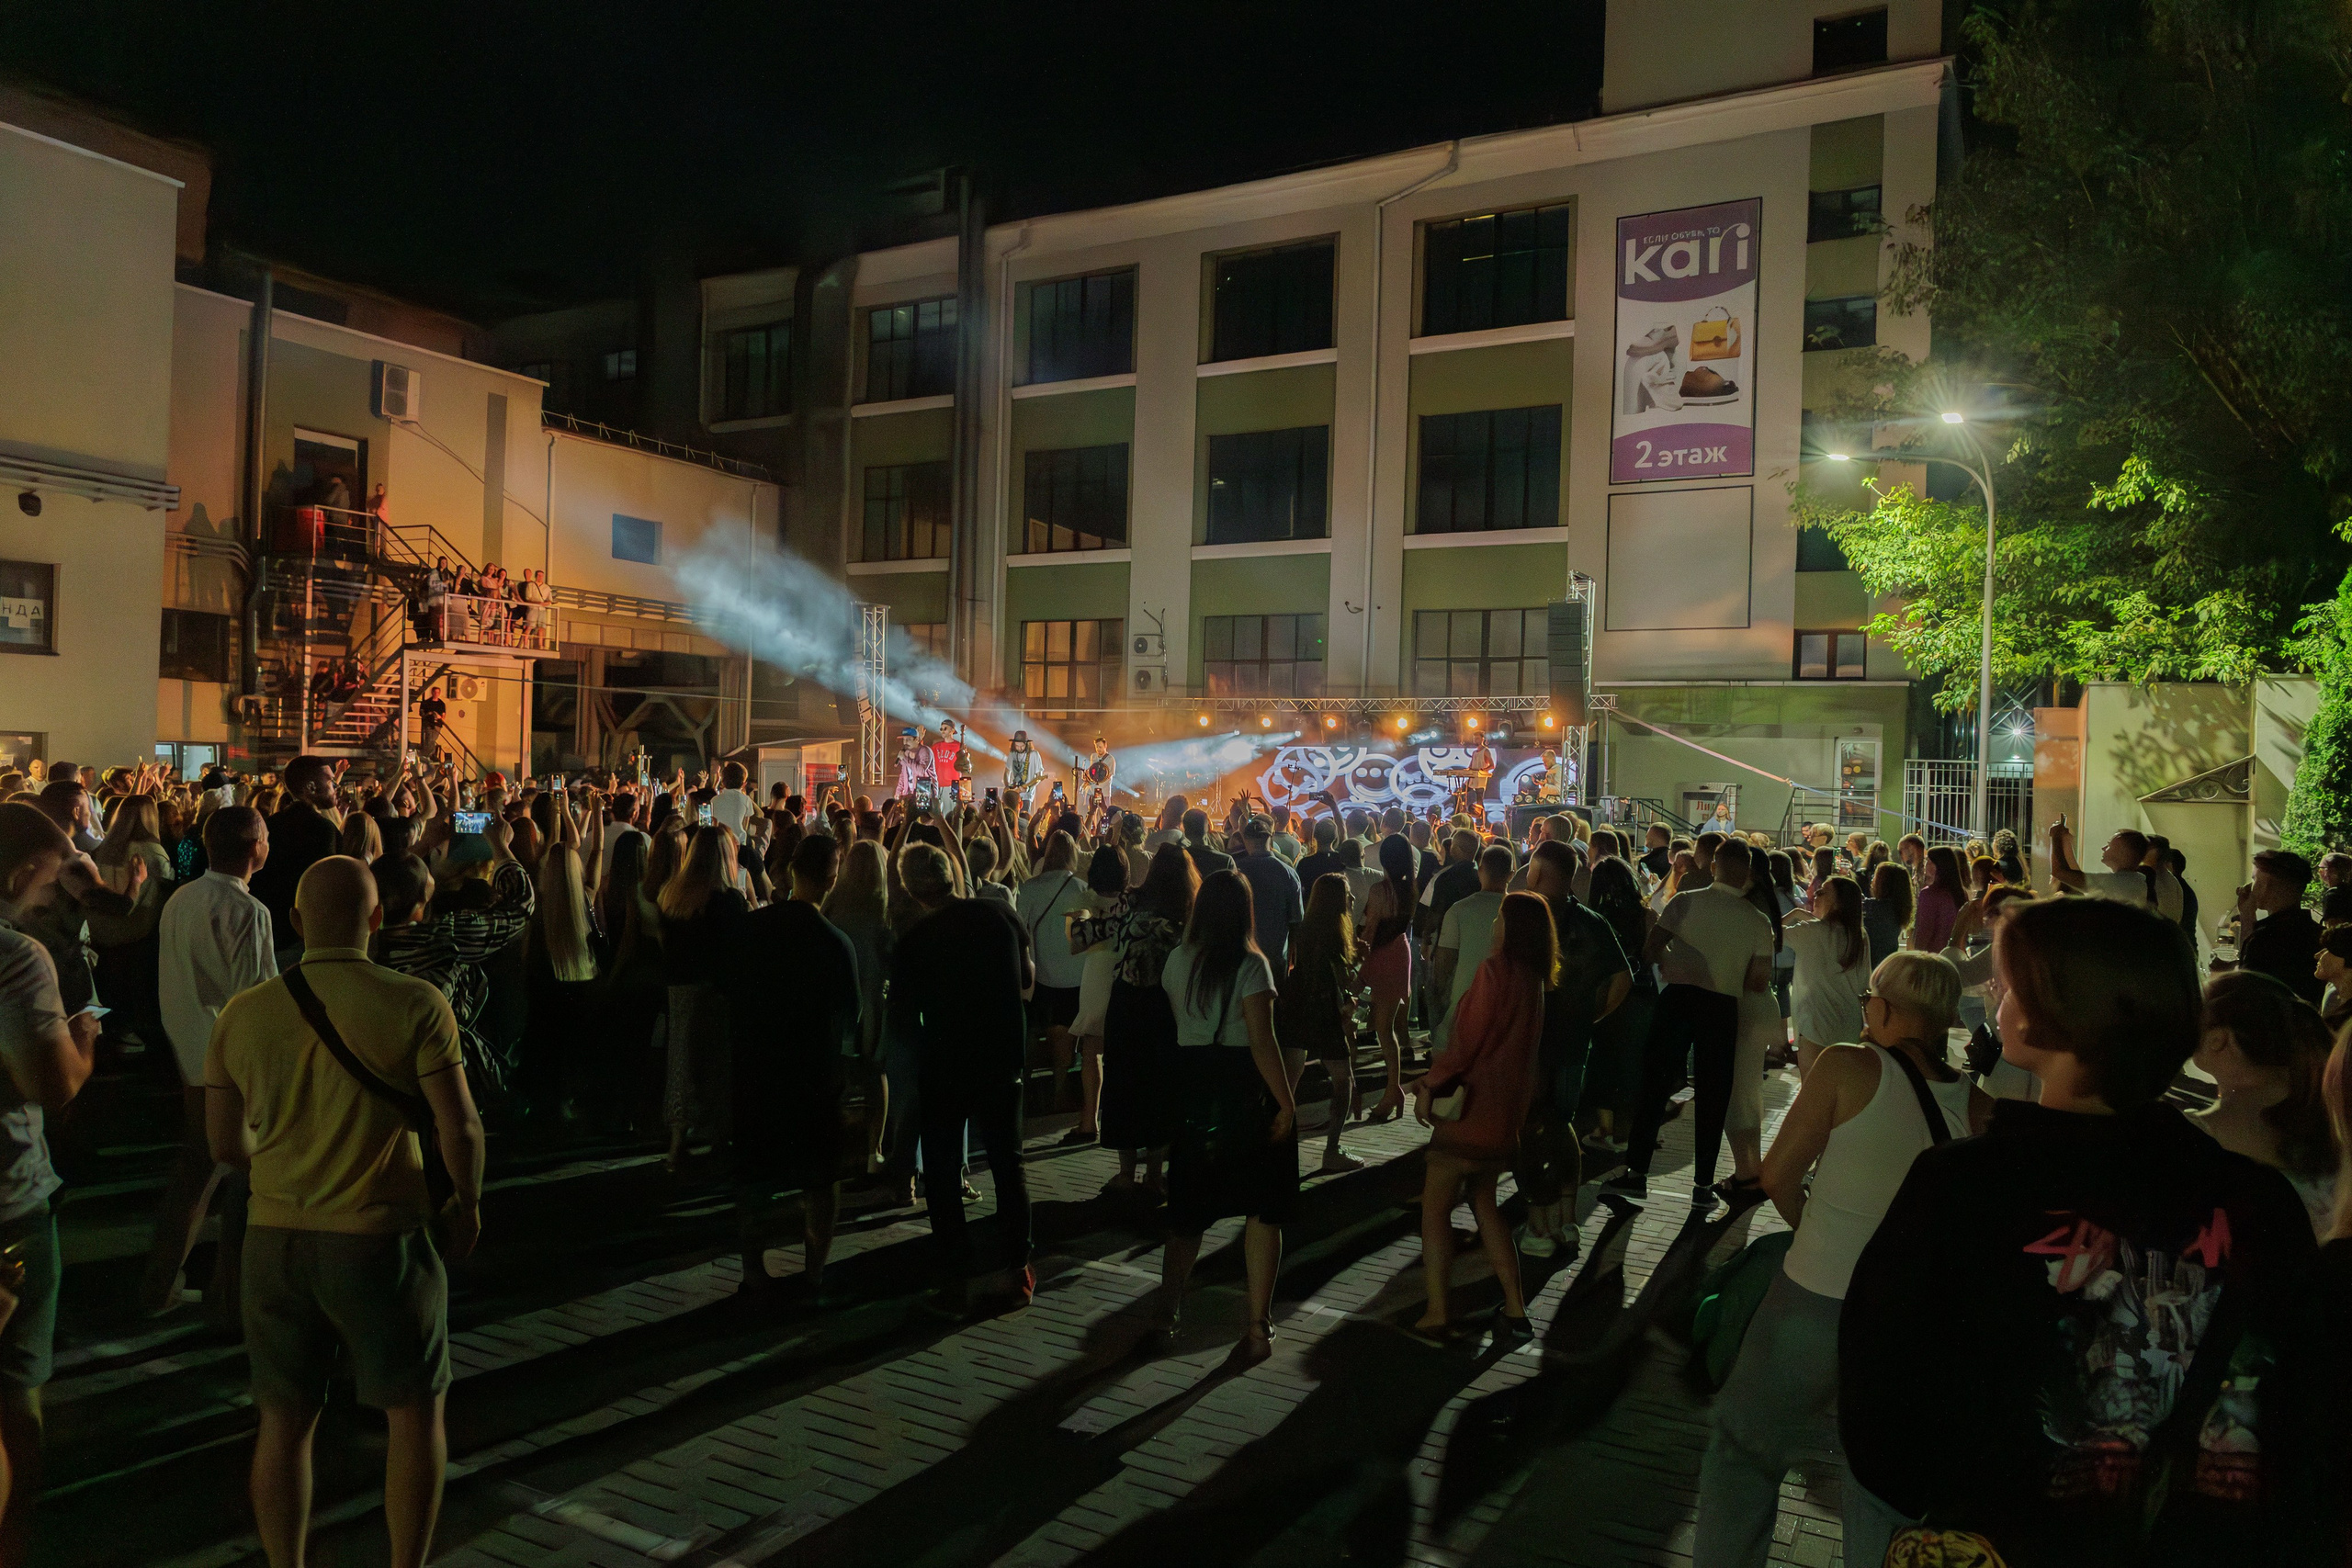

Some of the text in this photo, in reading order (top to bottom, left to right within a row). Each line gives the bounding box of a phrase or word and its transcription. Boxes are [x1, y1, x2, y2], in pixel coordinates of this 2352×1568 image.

[1643, 234, 1669, 244] ЕСЛИ
[1706, 226, 1721, 235] ТО
[1624, 222, 1751, 285] kari
[1634, 441, 1727, 468] 2 этаж
